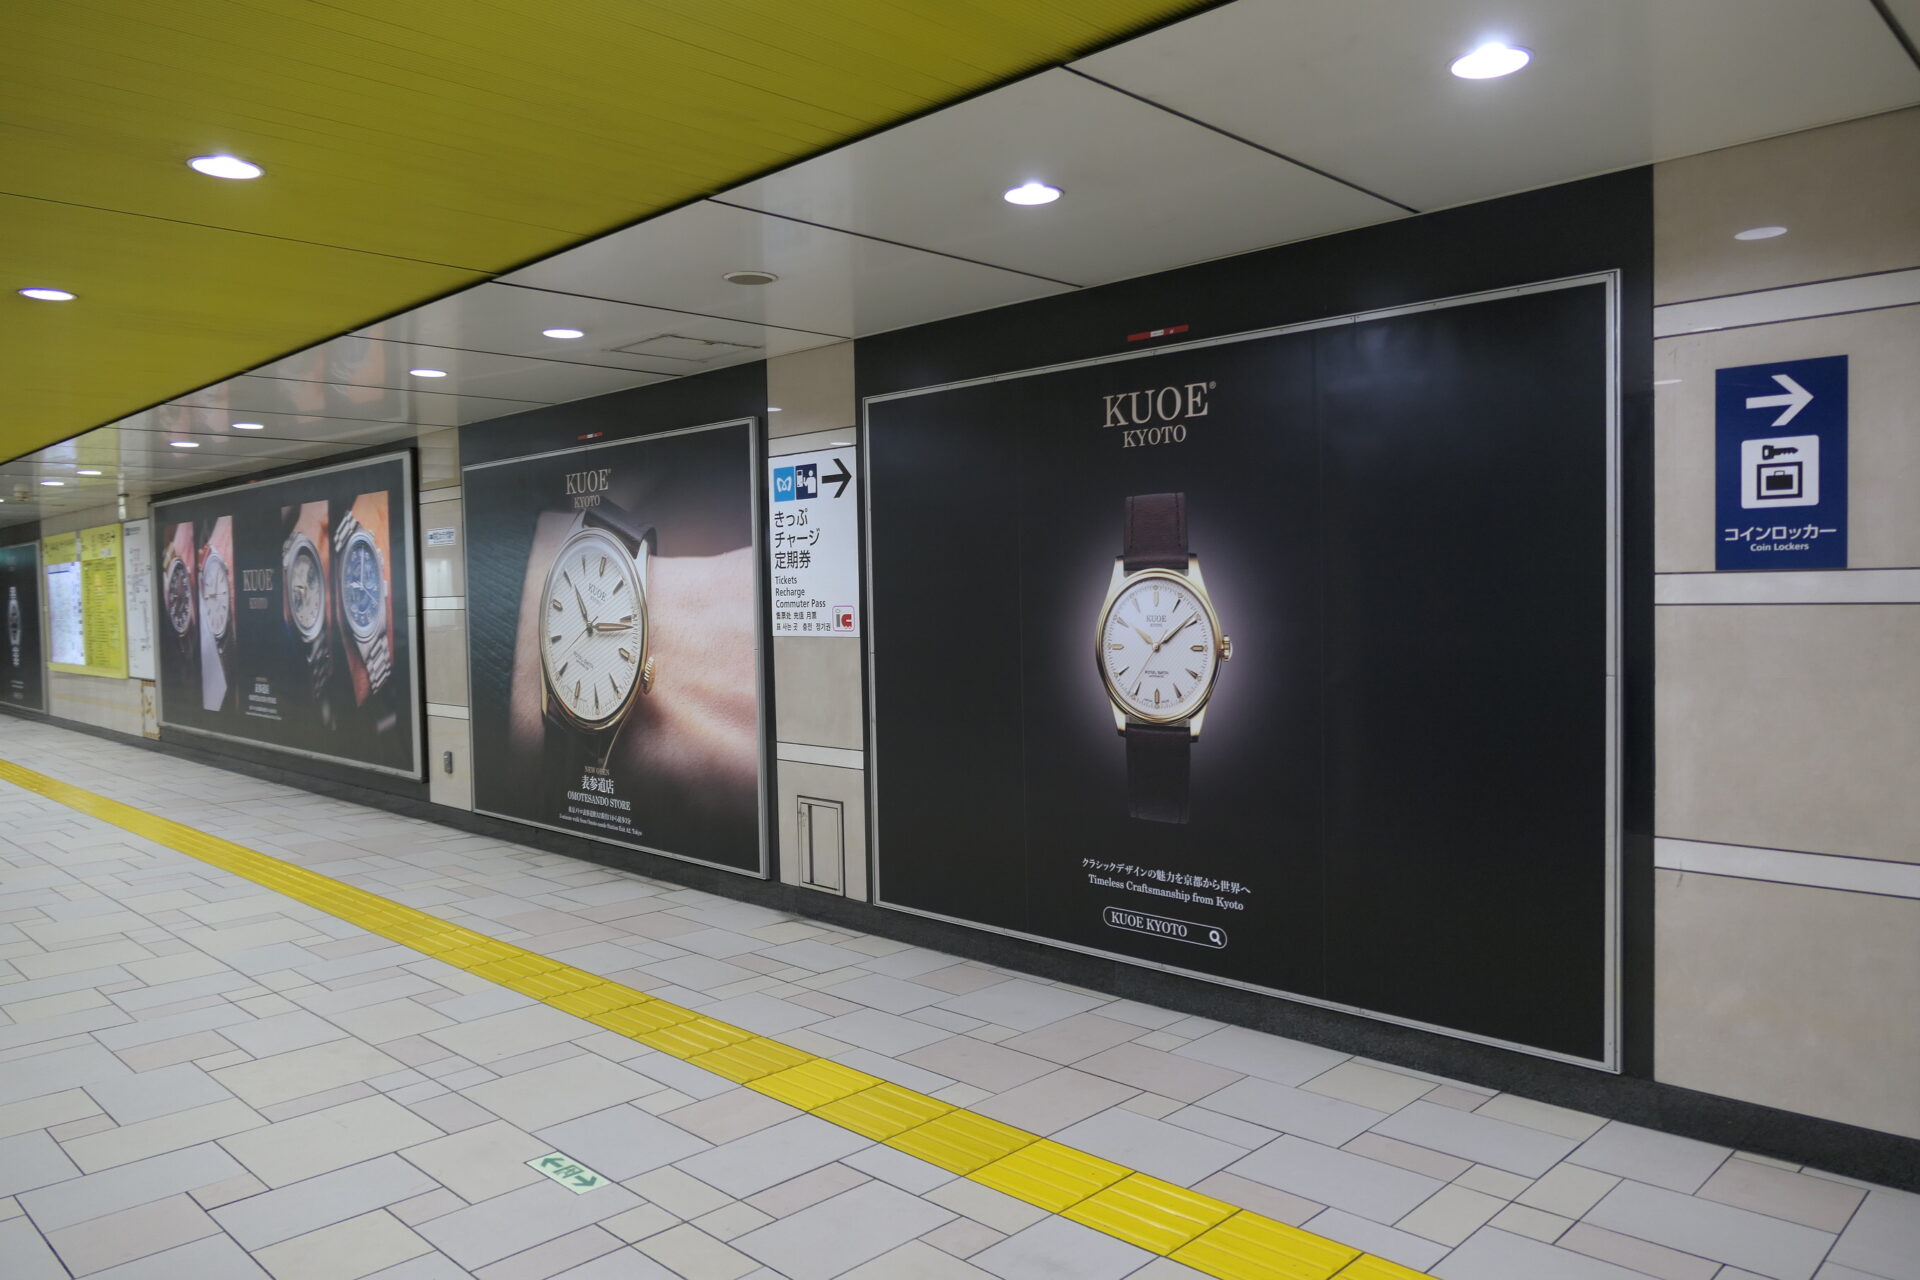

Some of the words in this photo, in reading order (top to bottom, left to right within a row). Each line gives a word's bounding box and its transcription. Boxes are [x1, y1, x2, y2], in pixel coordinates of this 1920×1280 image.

[1123, 424, 1187, 448] KYOTO
[574, 494, 601, 508] KYOTO
[774, 508, 808, 528] きっぷ
[774, 528, 820, 548] チャージ
[1724, 524, 1838, 542] コインロッカー
[1750, 543, 1772, 552] Coin
[1773, 542, 1810, 551] Lockers
[774, 550, 812, 569] 定期券
[775, 576, 798, 585] Tickets
[775, 588, 805, 598] Recharge
[775, 600, 810, 608] Commuter
[811, 599, 826, 608] Pass
[582, 774, 614, 794] 表参道店
[567, 790, 609, 807] OMOTESANDO
[609, 799, 631, 811] STORE
[1082, 857, 1251, 895] クラシックデザインの魅力を京都から世界へ
[1088, 873, 1125, 889] Timeless
[1126, 881, 1191, 903] Craftsmanship
[1192, 892, 1214, 906] from
[1216, 896, 1244, 911] Kyoto
[1111, 911, 1144, 929] KUOE
[1146, 918, 1188, 938] KYOTO
